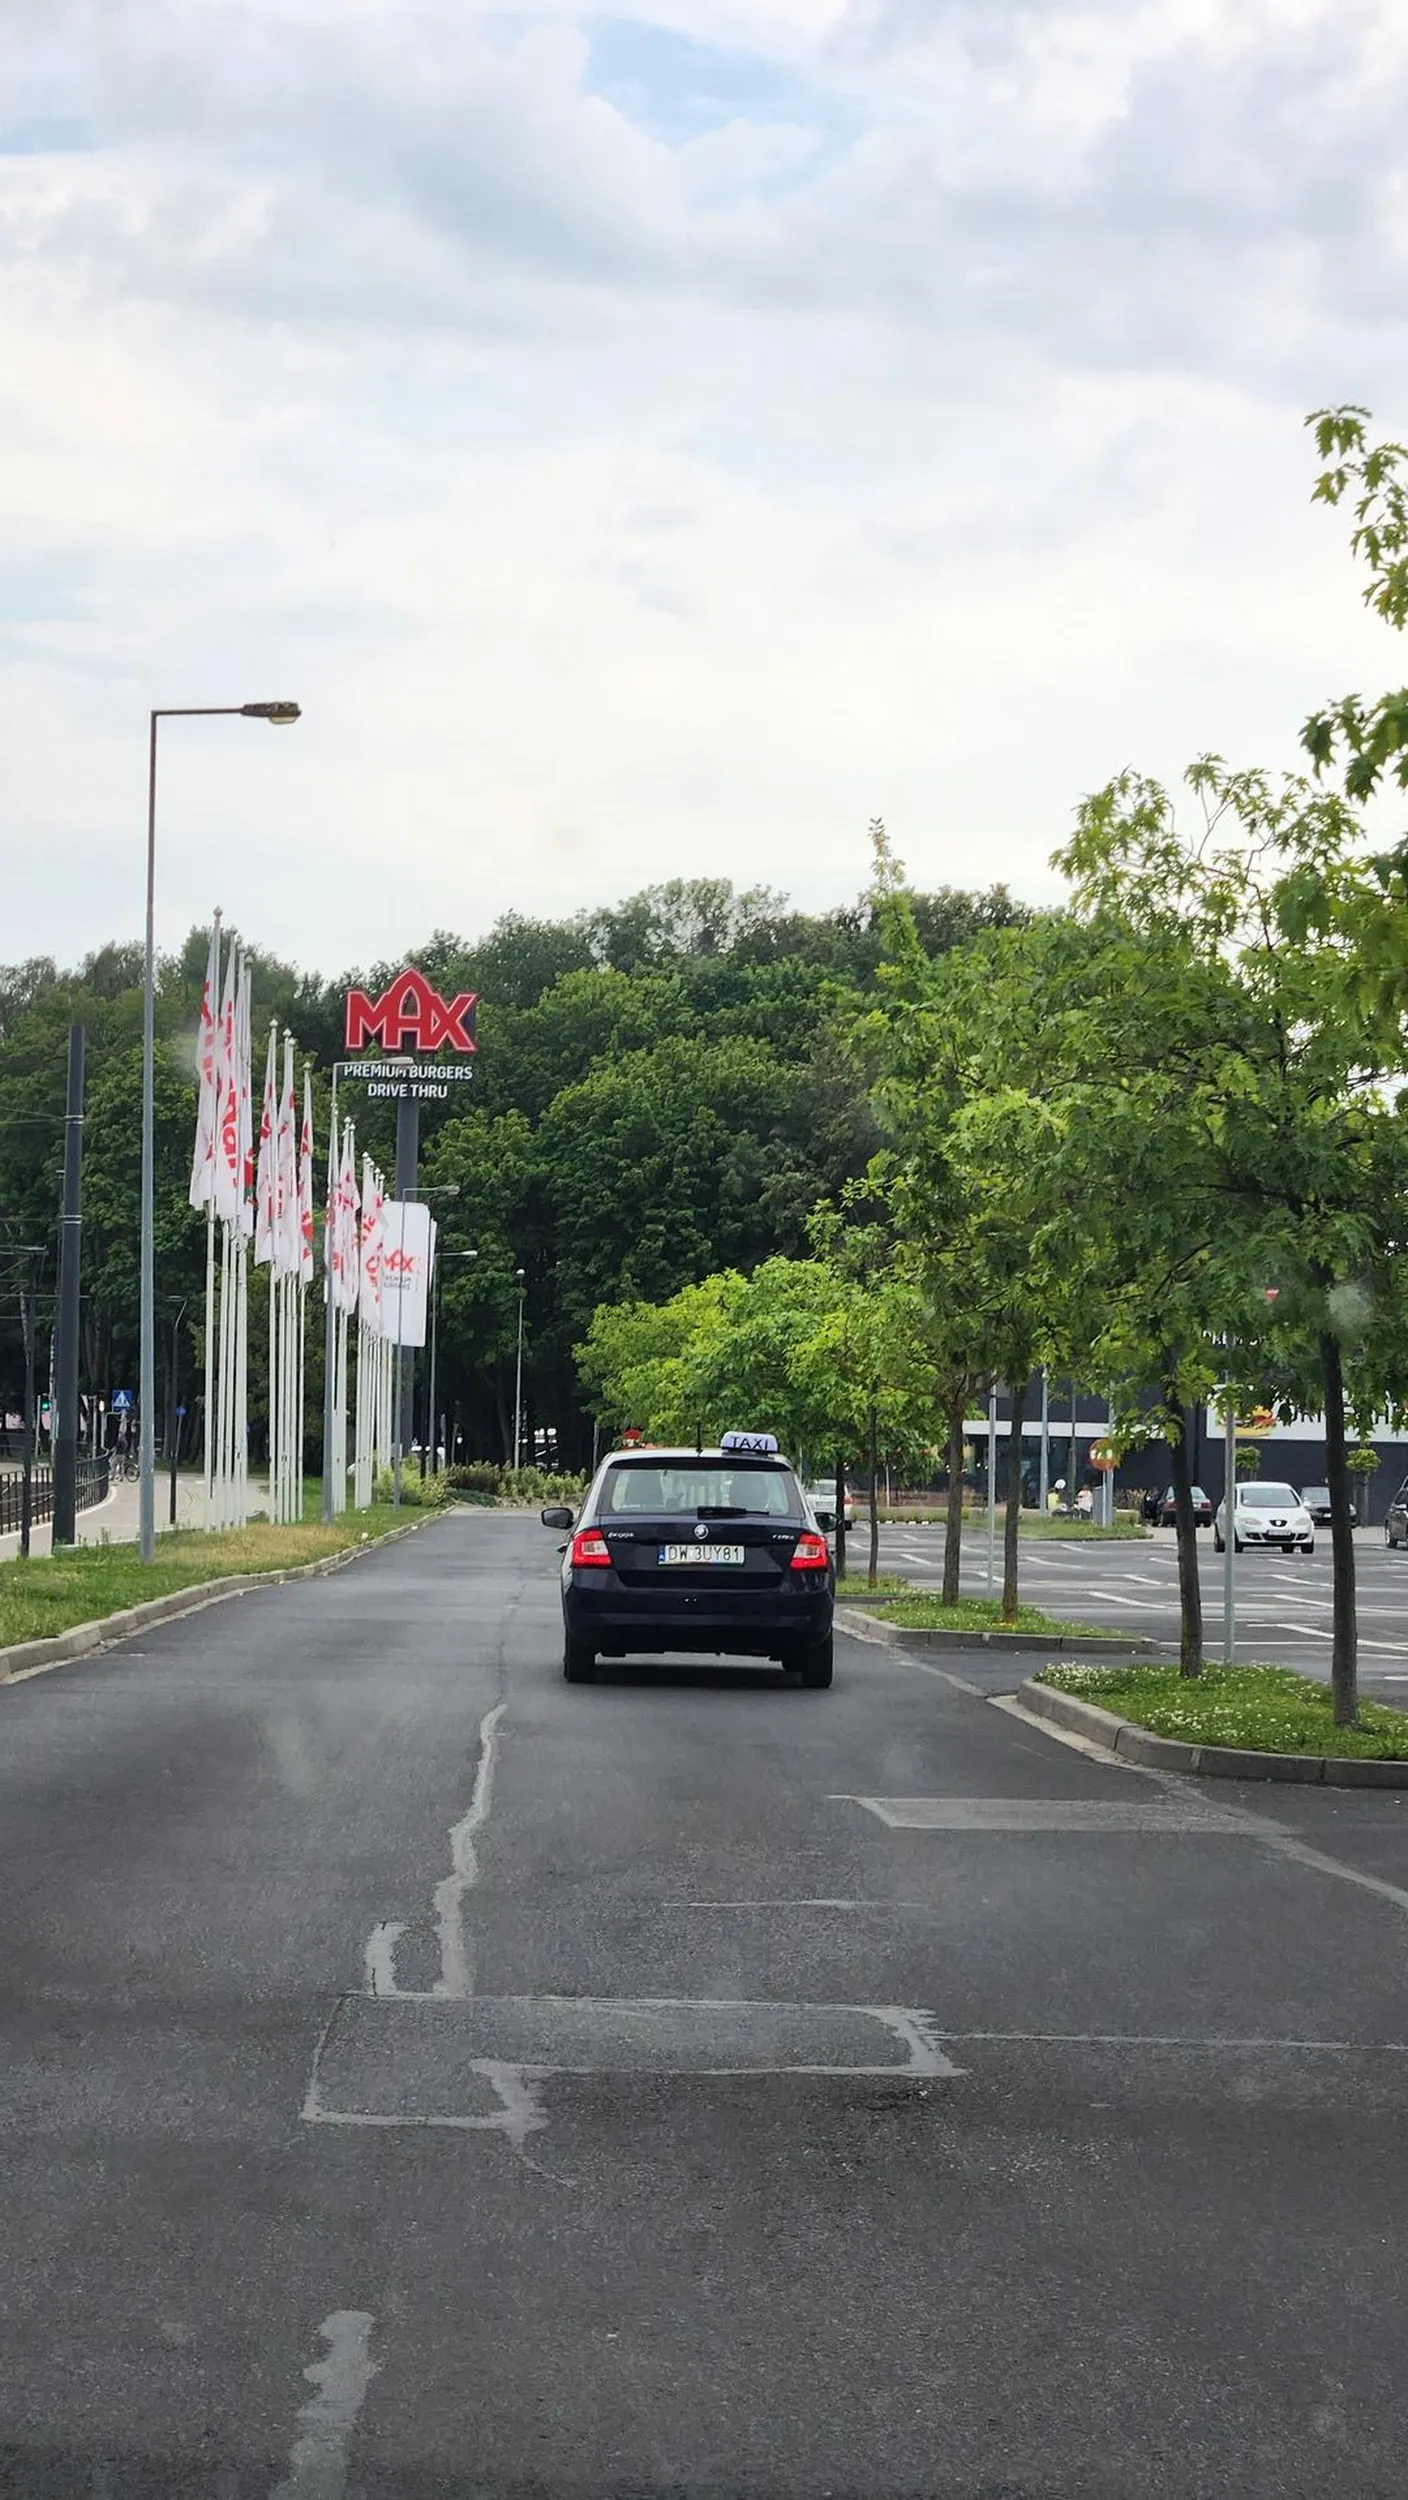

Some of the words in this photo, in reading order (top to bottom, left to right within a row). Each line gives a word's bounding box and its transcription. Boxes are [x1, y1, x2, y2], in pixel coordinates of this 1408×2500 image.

[346, 968, 477, 1051] MAX
[344, 1064, 407, 1078] PREMIUM
[409, 1064, 473, 1080] BURGERS
[367, 1083, 408, 1098] DRIVE
[410, 1083, 448, 1099] THRU
[730, 1435, 769, 1450] TAXI
[668, 1545, 688, 1560] DW
[694, 1545, 739, 1561] 3UY81
